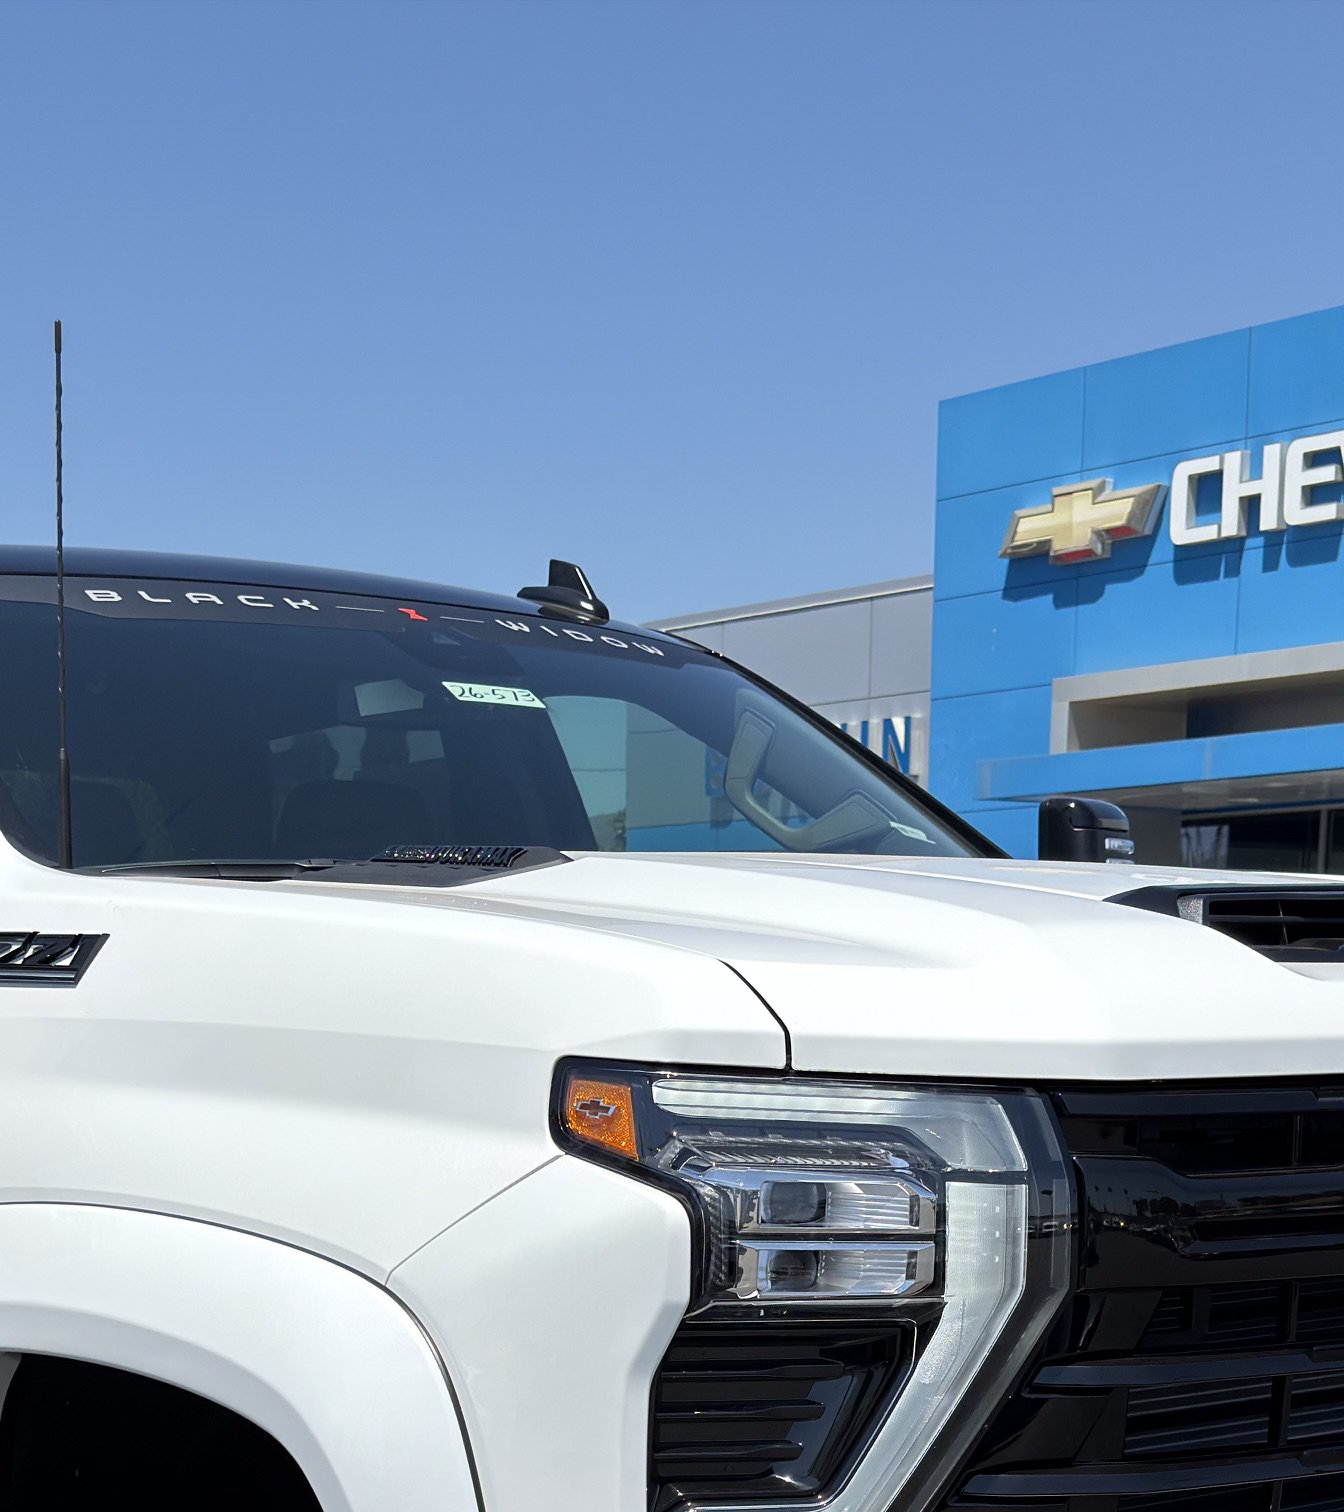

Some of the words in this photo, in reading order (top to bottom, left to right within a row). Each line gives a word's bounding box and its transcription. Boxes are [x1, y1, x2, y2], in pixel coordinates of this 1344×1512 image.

[84, 590, 320, 611] BLACK
[494, 619, 665, 656] WIDOW
[450, 684, 536, 703] 26-573
